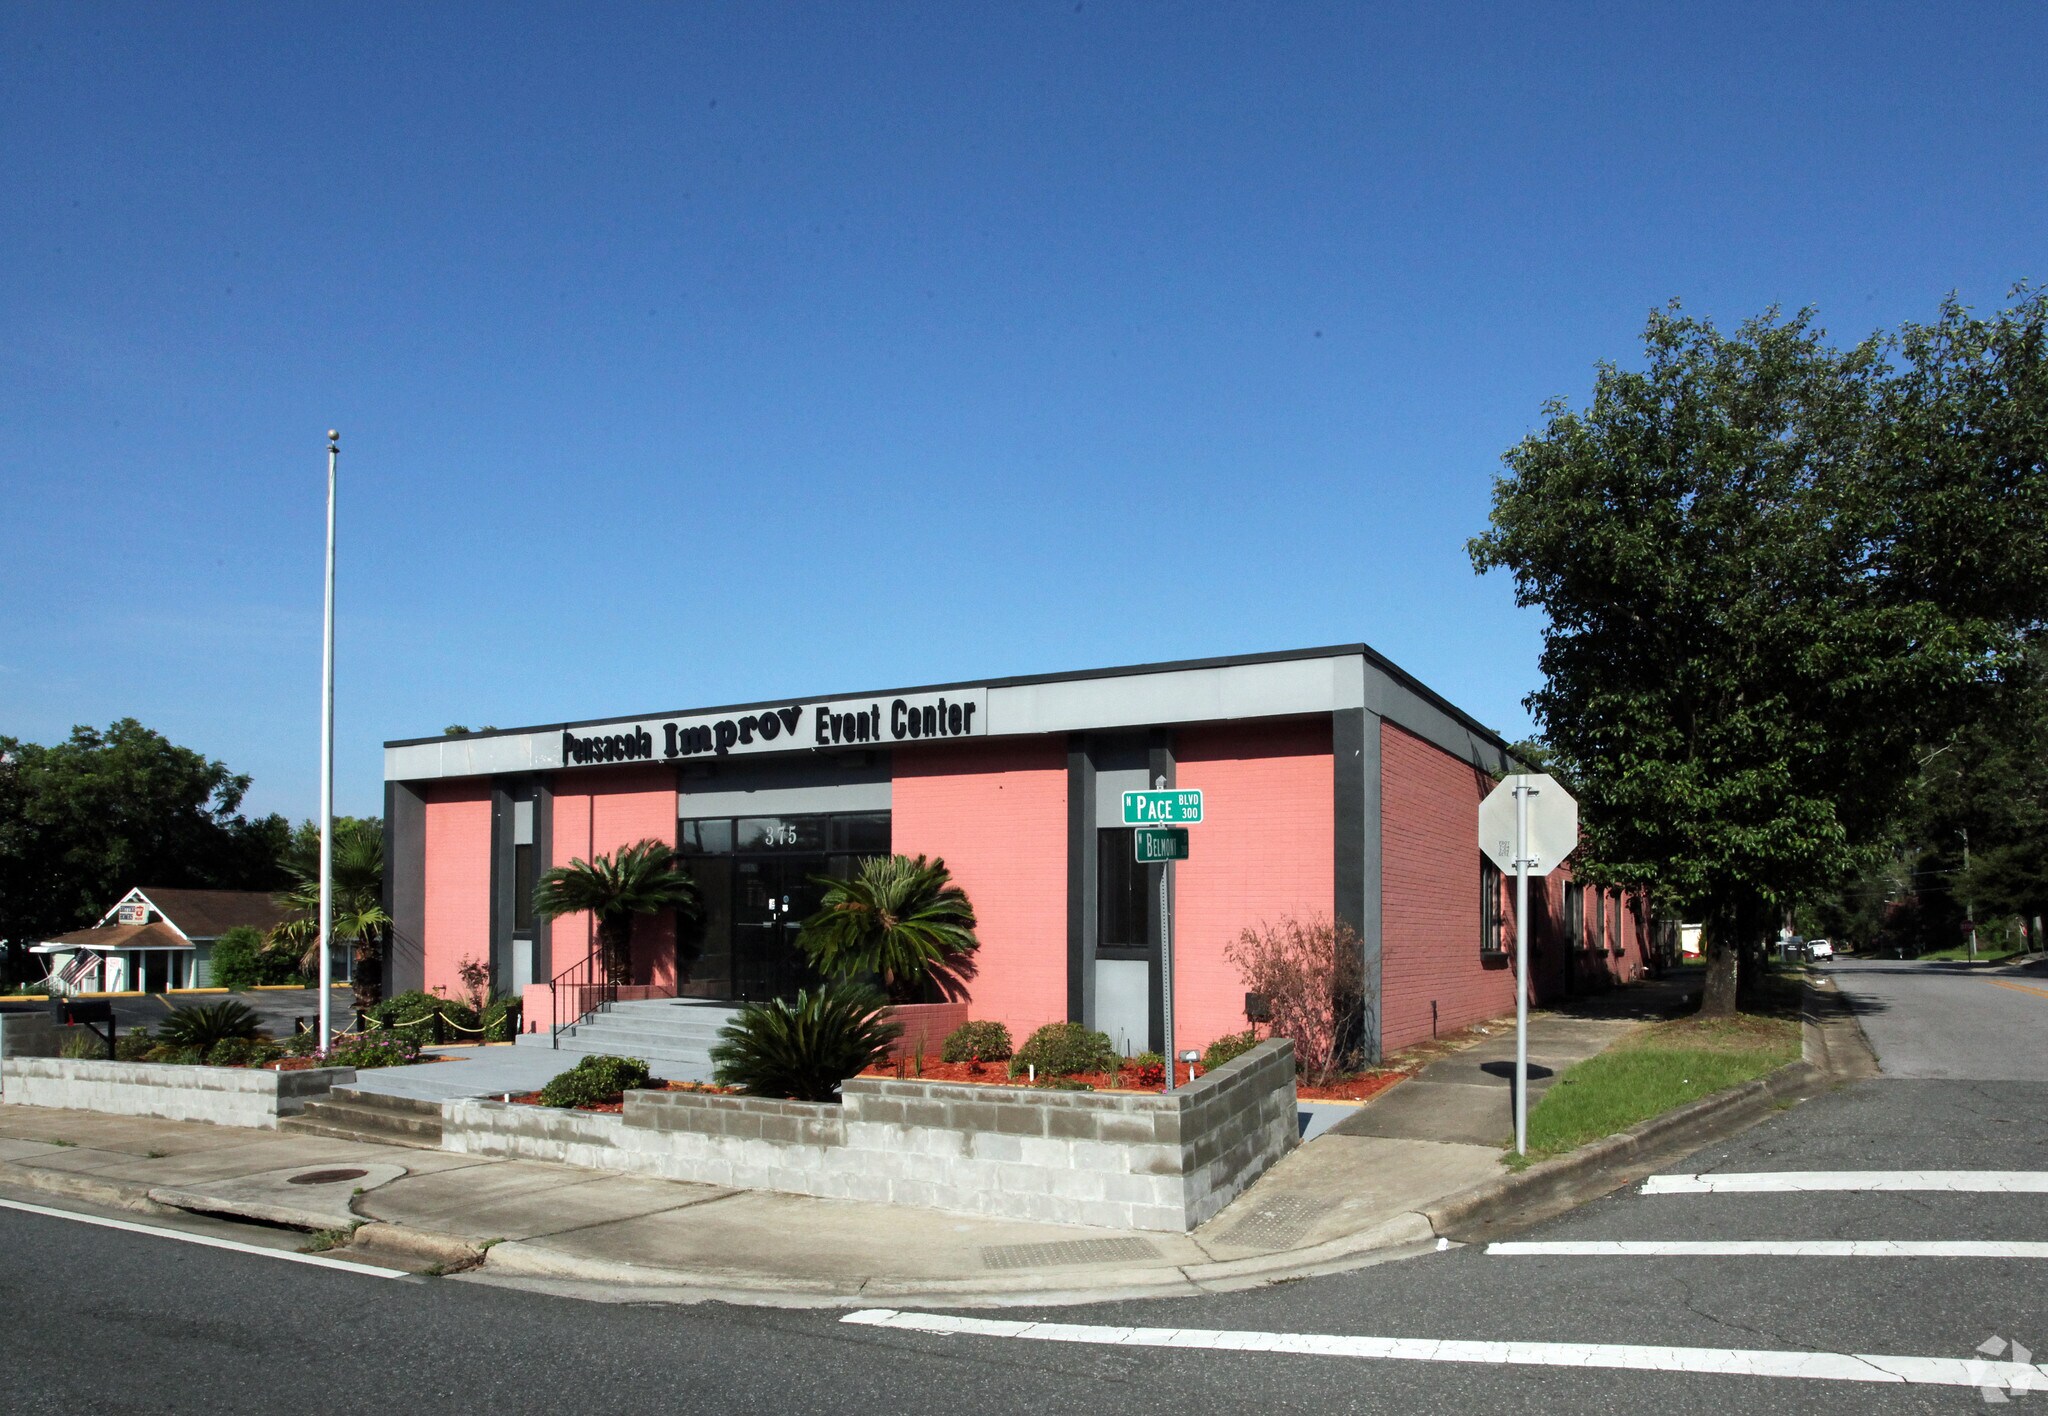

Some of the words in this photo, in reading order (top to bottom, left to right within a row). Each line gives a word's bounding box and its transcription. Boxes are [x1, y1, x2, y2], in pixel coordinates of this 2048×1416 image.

[563, 725, 652, 766] Pensacola
[663, 705, 803, 758] Improv
[815, 704, 880, 745] Event
[891, 698, 976, 740] Center
[1126, 795, 1132, 807] N
[1136, 795, 1173, 819] PACE
[1178, 794, 1199, 806] BLVD
[1181, 807, 1198, 819] 300
[765, 825, 797, 846] 375
[1146, 832, 1177, 858] BELMONT
